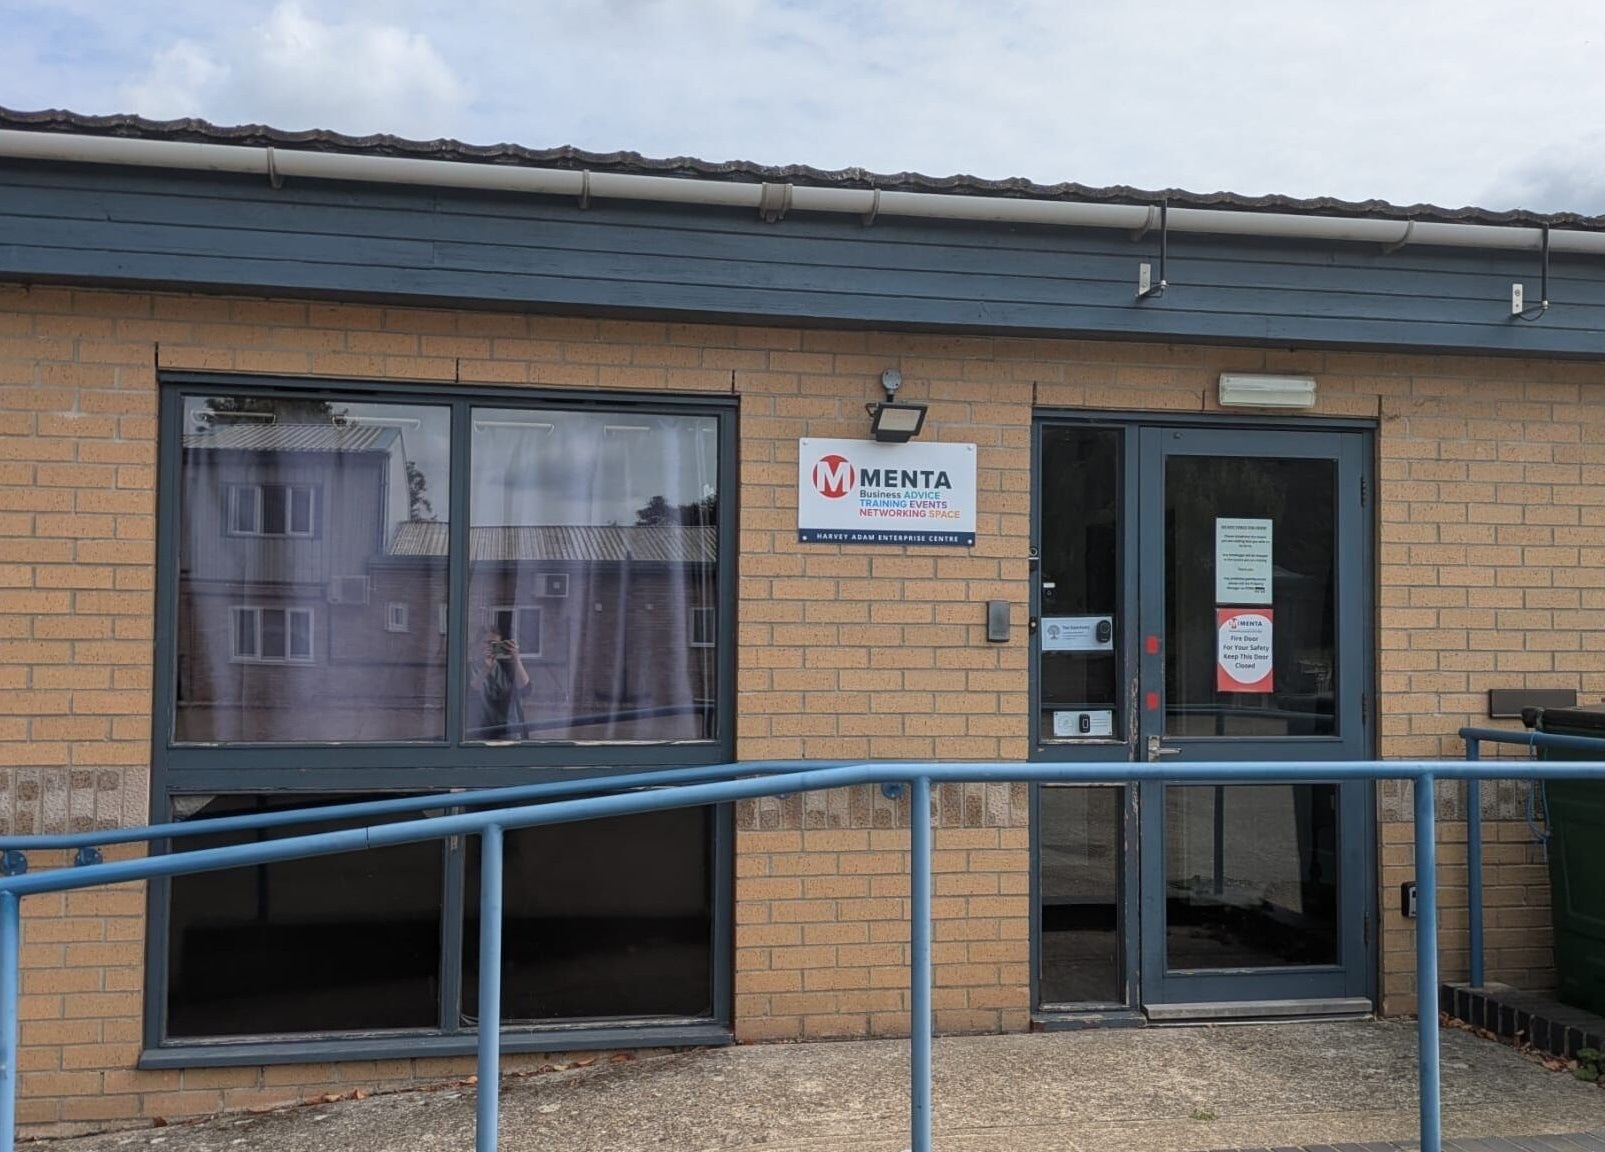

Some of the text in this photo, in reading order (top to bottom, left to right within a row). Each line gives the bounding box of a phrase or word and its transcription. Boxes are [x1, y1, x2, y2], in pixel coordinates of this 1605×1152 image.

[860, 468, 953, 489] MENTA
[860, 490, 941, 500] Business ADVICE
[860, 499, 947, 509] TRAINING EVENTS
[859, 508, 960, 518] NETWORKING SPACE
[851, 533, 875, 541] ADAM
[878, 534, 925, 542] ENTERPRISE
[1223, 653, 1239, 661] Keep
